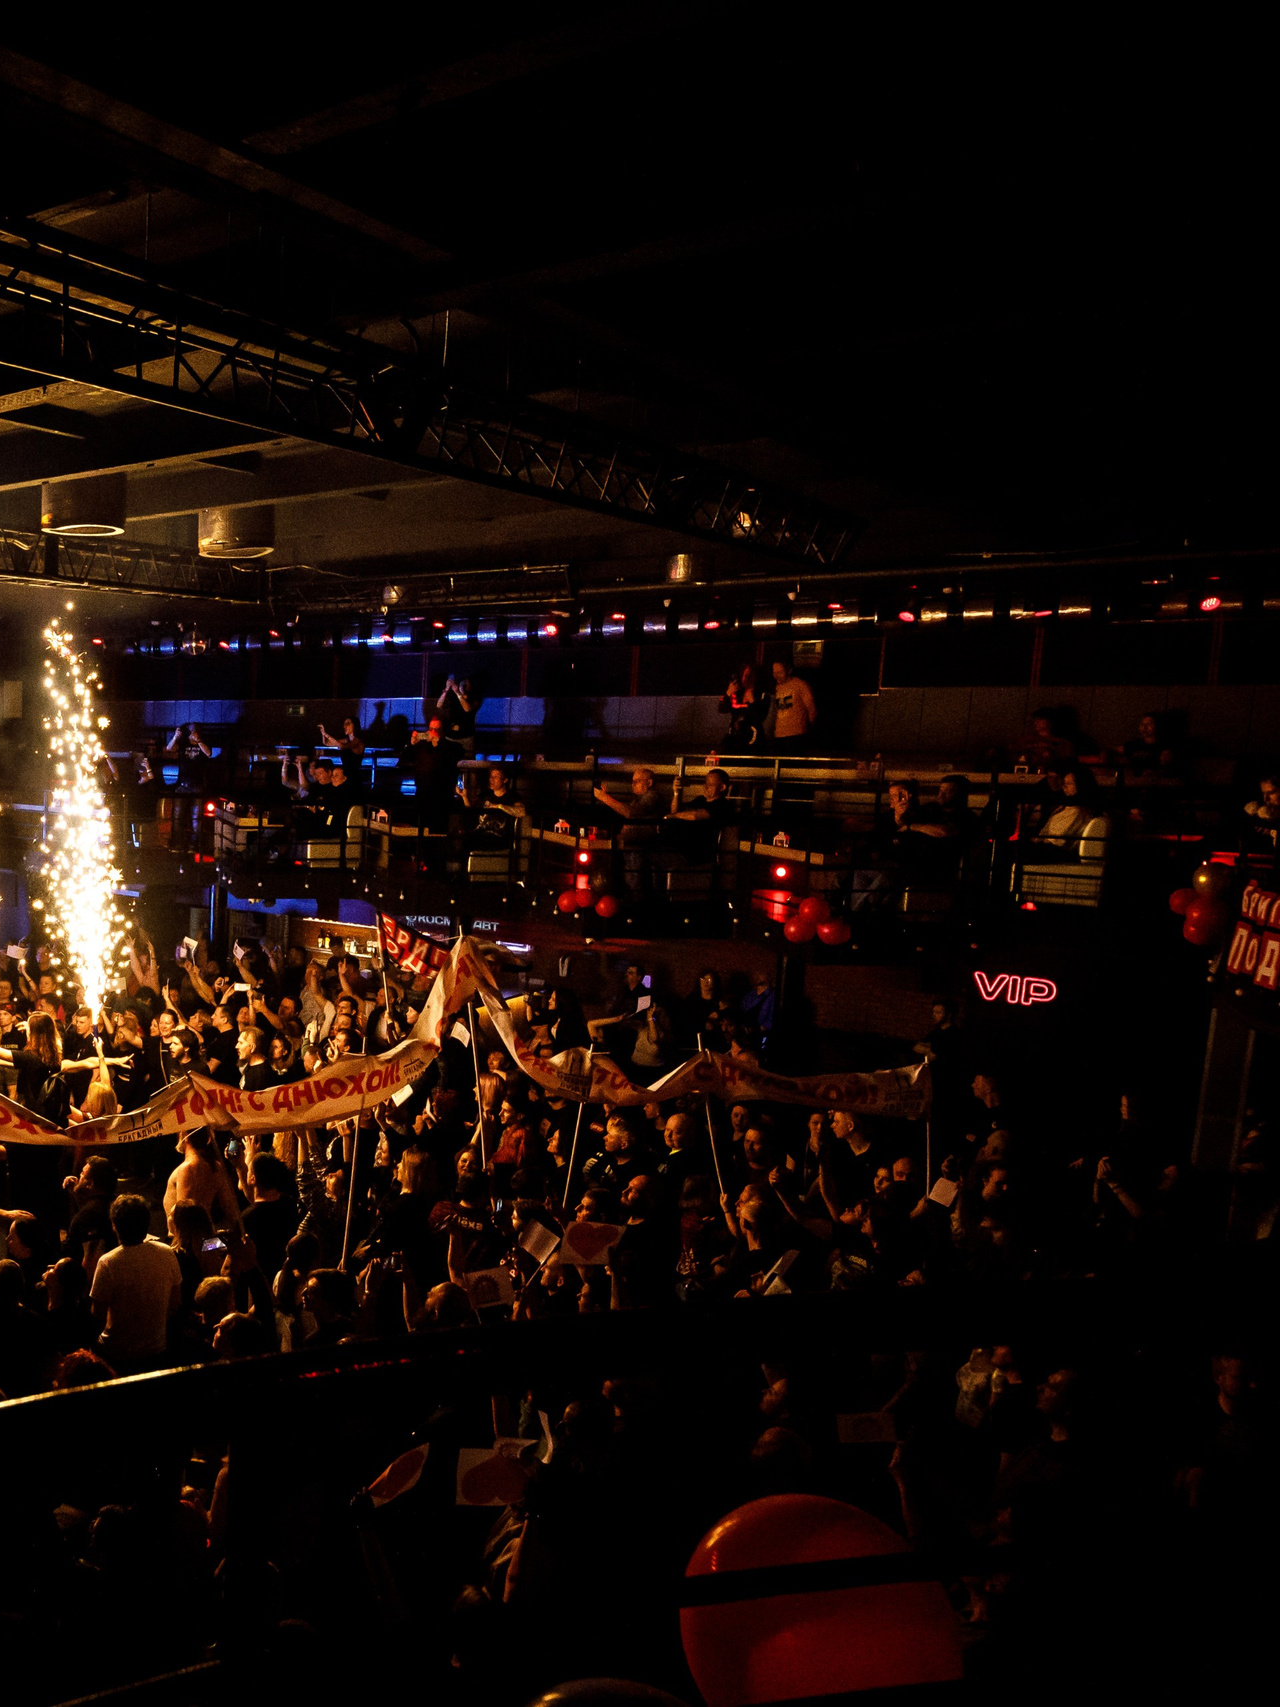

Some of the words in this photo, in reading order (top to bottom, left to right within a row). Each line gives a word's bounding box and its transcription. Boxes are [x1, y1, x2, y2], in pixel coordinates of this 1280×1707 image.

[974, 971, 1057, 1006] VIP
[247, 1091, 266, 1111] С
[272, 1060, 401, 1114] ДНЮХОЙ!
